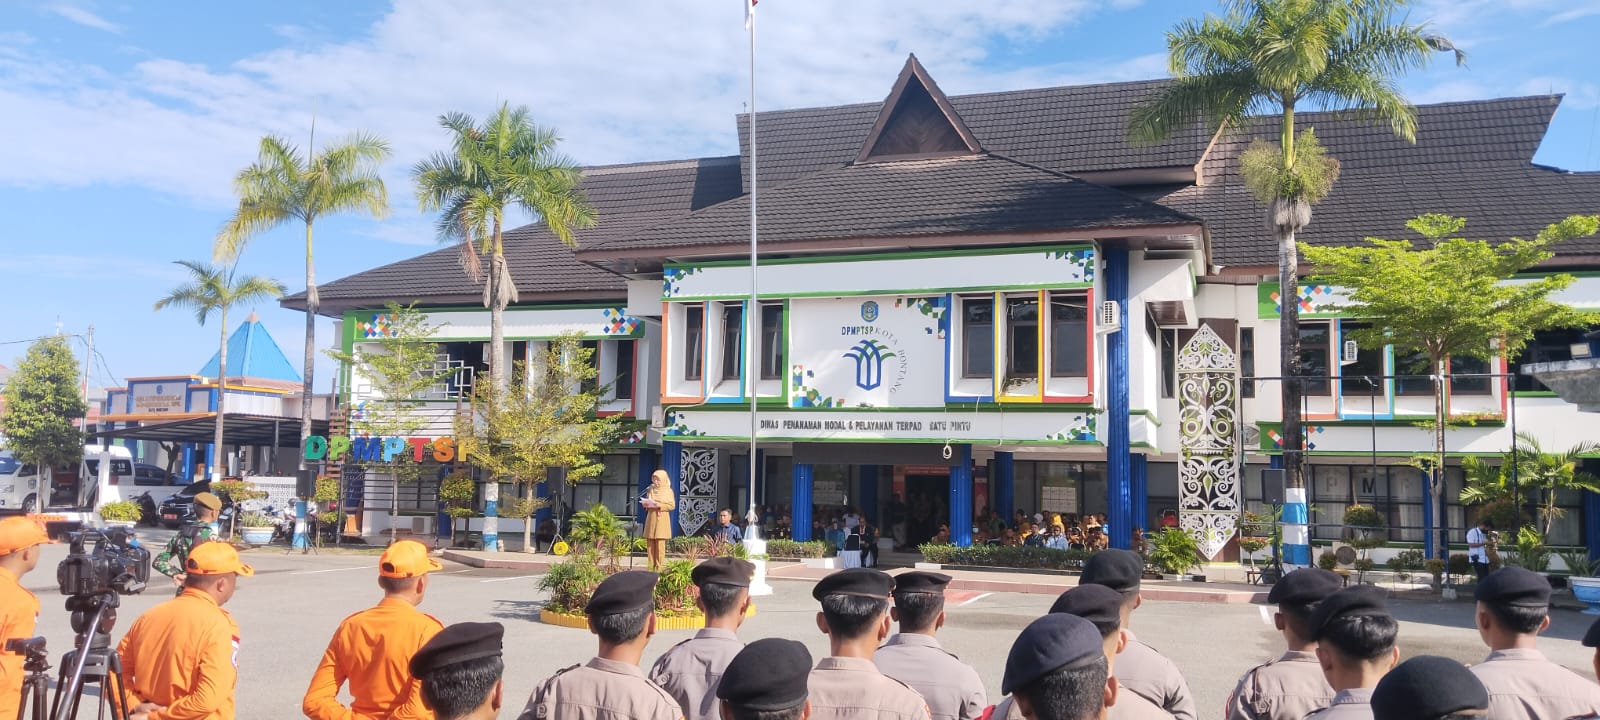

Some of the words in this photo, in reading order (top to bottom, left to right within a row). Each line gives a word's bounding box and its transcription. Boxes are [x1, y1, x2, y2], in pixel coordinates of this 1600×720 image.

[841, 326, 874, 336] DPMPTSP
[760, 419, 779, 430] DINAS
[824, 420, 846, 431] MODAL
[855, 421, 893, 432] PELAYANAN
